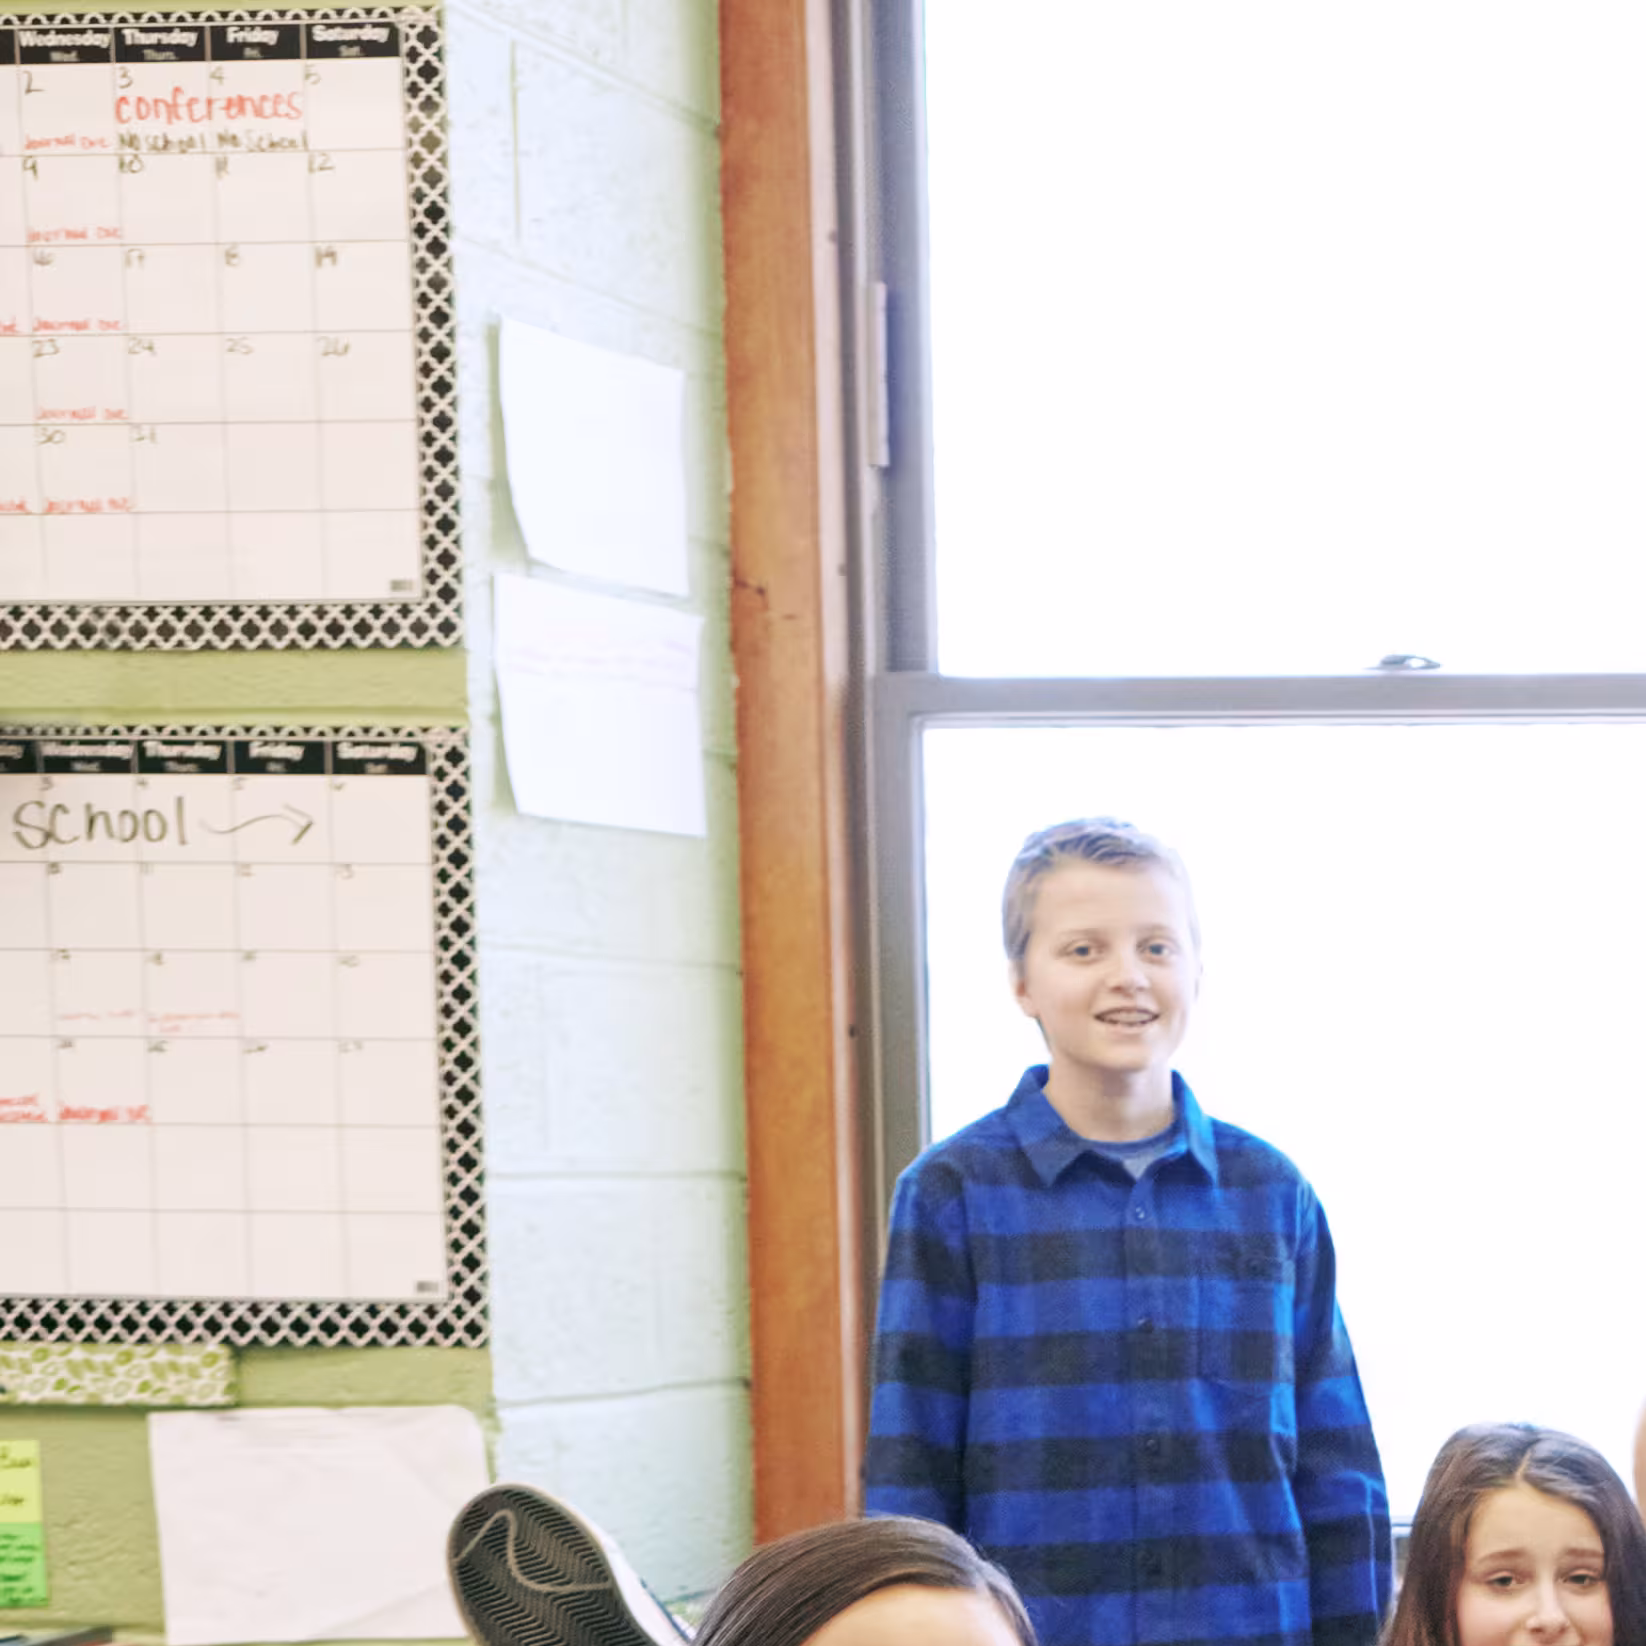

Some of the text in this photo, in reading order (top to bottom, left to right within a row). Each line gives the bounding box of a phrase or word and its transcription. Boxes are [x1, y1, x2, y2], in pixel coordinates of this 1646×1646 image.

[18, 28, 112, 48] Wednesday
[121, 27, 198, 47] Thursday
[226, 25, 279, 46] Friday
[311, 23, 390, 43] Saturday
[23, 70, 44, 94] 2
[118, 66, 133, 89] 3
[209, 66, 225, 85] 4
[305, 64, 322, 85] 5
[22, 156, 38, 181] 9
[119, 154, 144, 174] 10
[307, 152, 336, 174] 12
[32, 338, 60, 358] 23
[128, 336, 157, 356] 24
[225, 336, 255, 355] 25
[36, 427, 65, 445] 30
[12, 796, 188, 849] School
